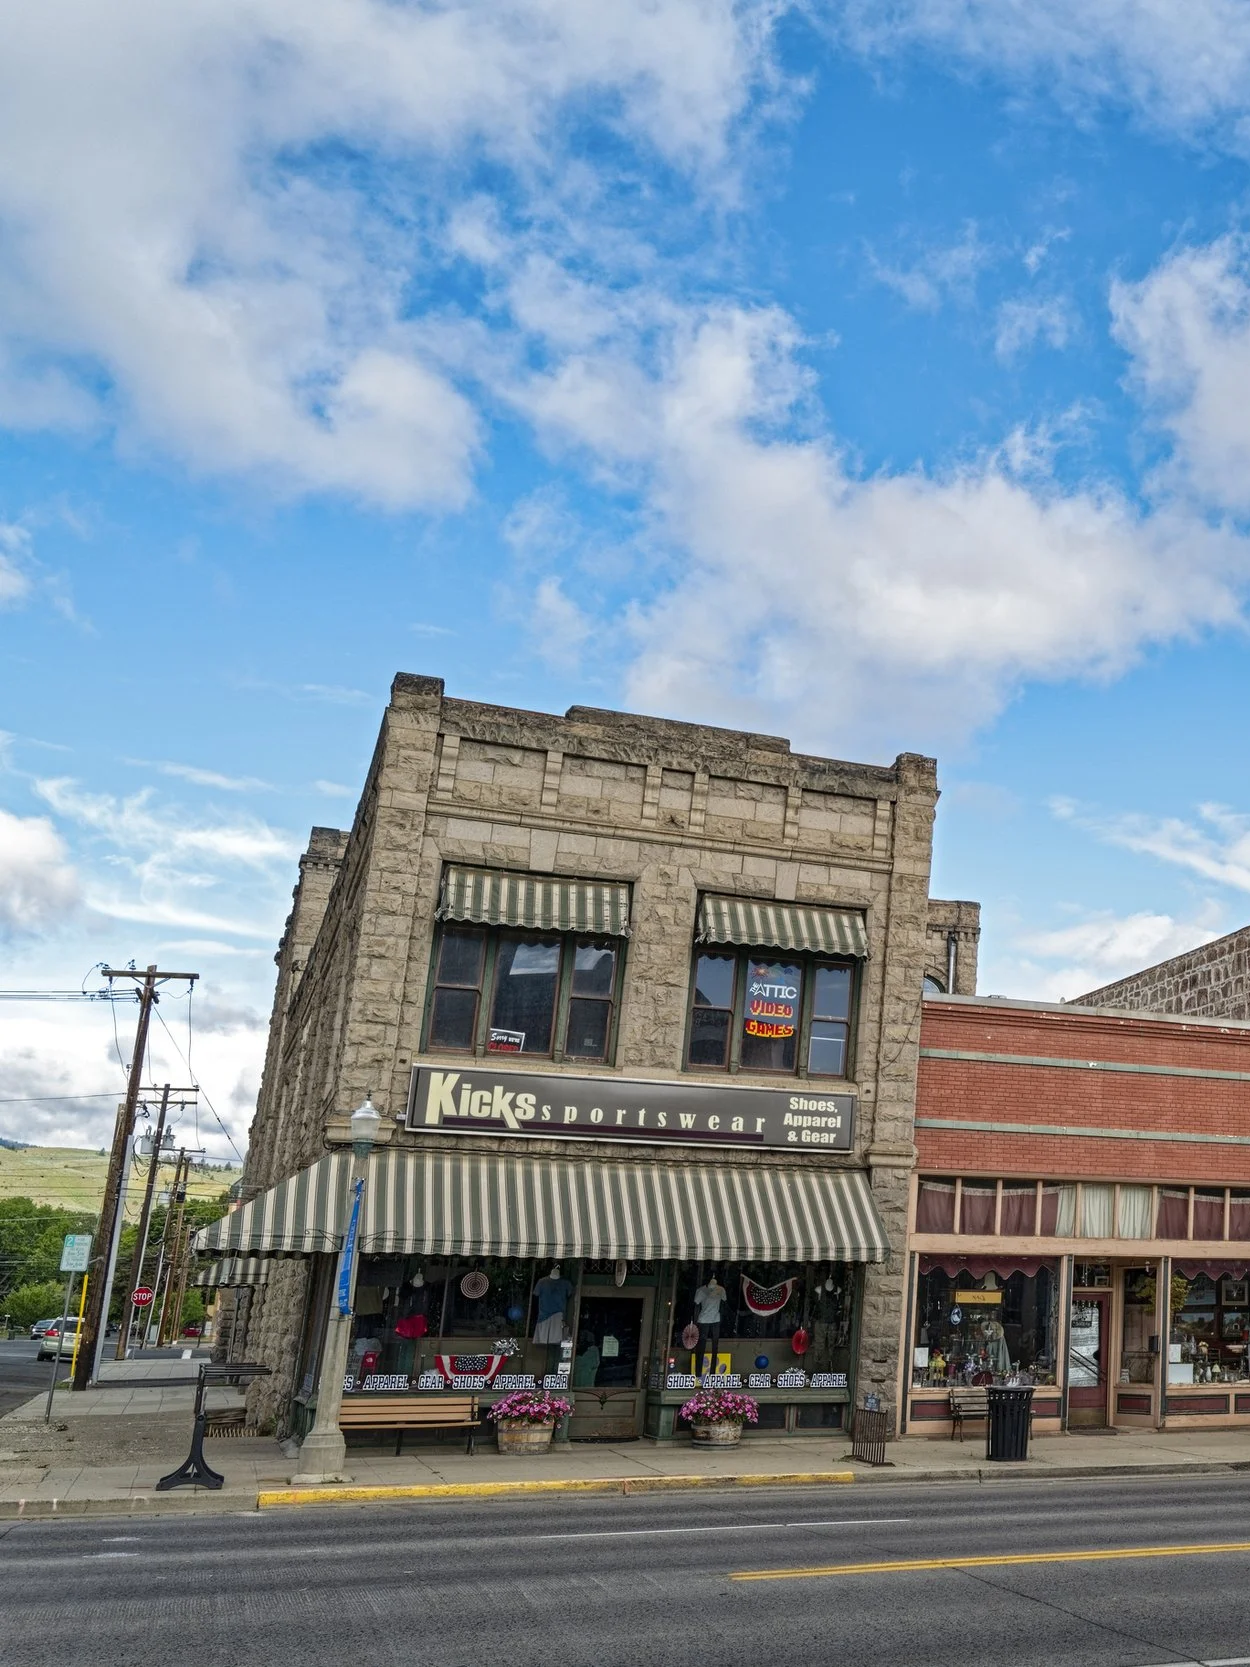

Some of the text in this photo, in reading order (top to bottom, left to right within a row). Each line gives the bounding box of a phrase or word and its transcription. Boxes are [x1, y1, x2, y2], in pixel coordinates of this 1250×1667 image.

[749, 982, 797, 999] THE ATTIC
[750, 1000, 794, 1018] VIDEO
[745, 1020, 795, 1038] GAMES
[424, 1071, 766, 1133] Kicks sportswear
[789, 1096, 838, 1113] Shoes,
[783, 1112, 842, 1129] Apparel
[787, 1131, 837, 1144] & Gear
[66, 1236, 74, 1247] 2
[132, 1292, 153, 1301] STOP
[362, 1374, 409, 1390] APPAREL
[417, 1374, 444, 1390] GEAR
[452, 1374, 485, 1390] SHOES
[492, 1374, 536, 1390] APPAREL
[542, 1374, 568, 1389] GEAR
[667, 1374, 696, 1389] SHOES
[702, 1374, 743, 1388] APPAREL
[749, 1374, 771, 1388] GEAR
[777, 1373, 805, 1387] SHOES
[810, 1373, 848, 1388] APPAREL
